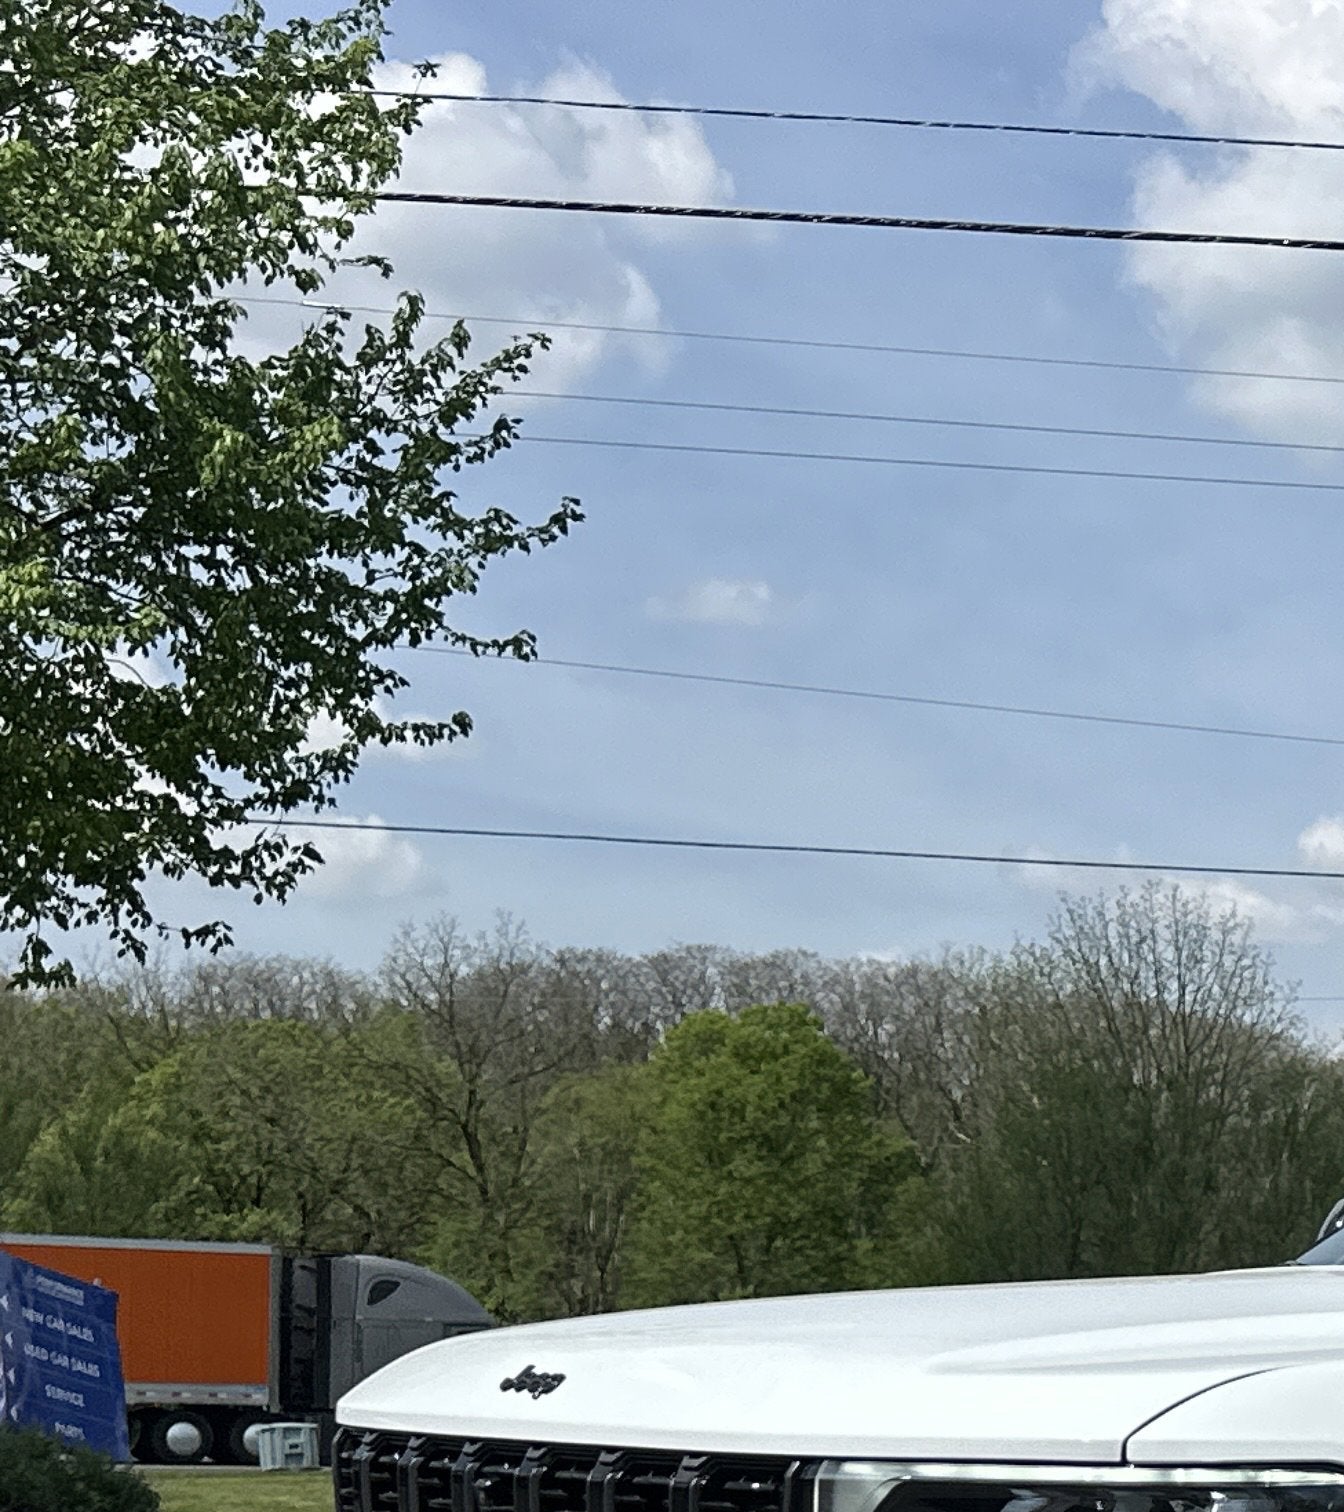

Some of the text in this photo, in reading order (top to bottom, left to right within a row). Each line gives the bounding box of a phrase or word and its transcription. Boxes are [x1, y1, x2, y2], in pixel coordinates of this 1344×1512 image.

[22, 1306, 95, 1343] NEW CAR SALES
[71, 1357, 100, 1379] SALES
[500, 1364, 567, 1400] Jeep
